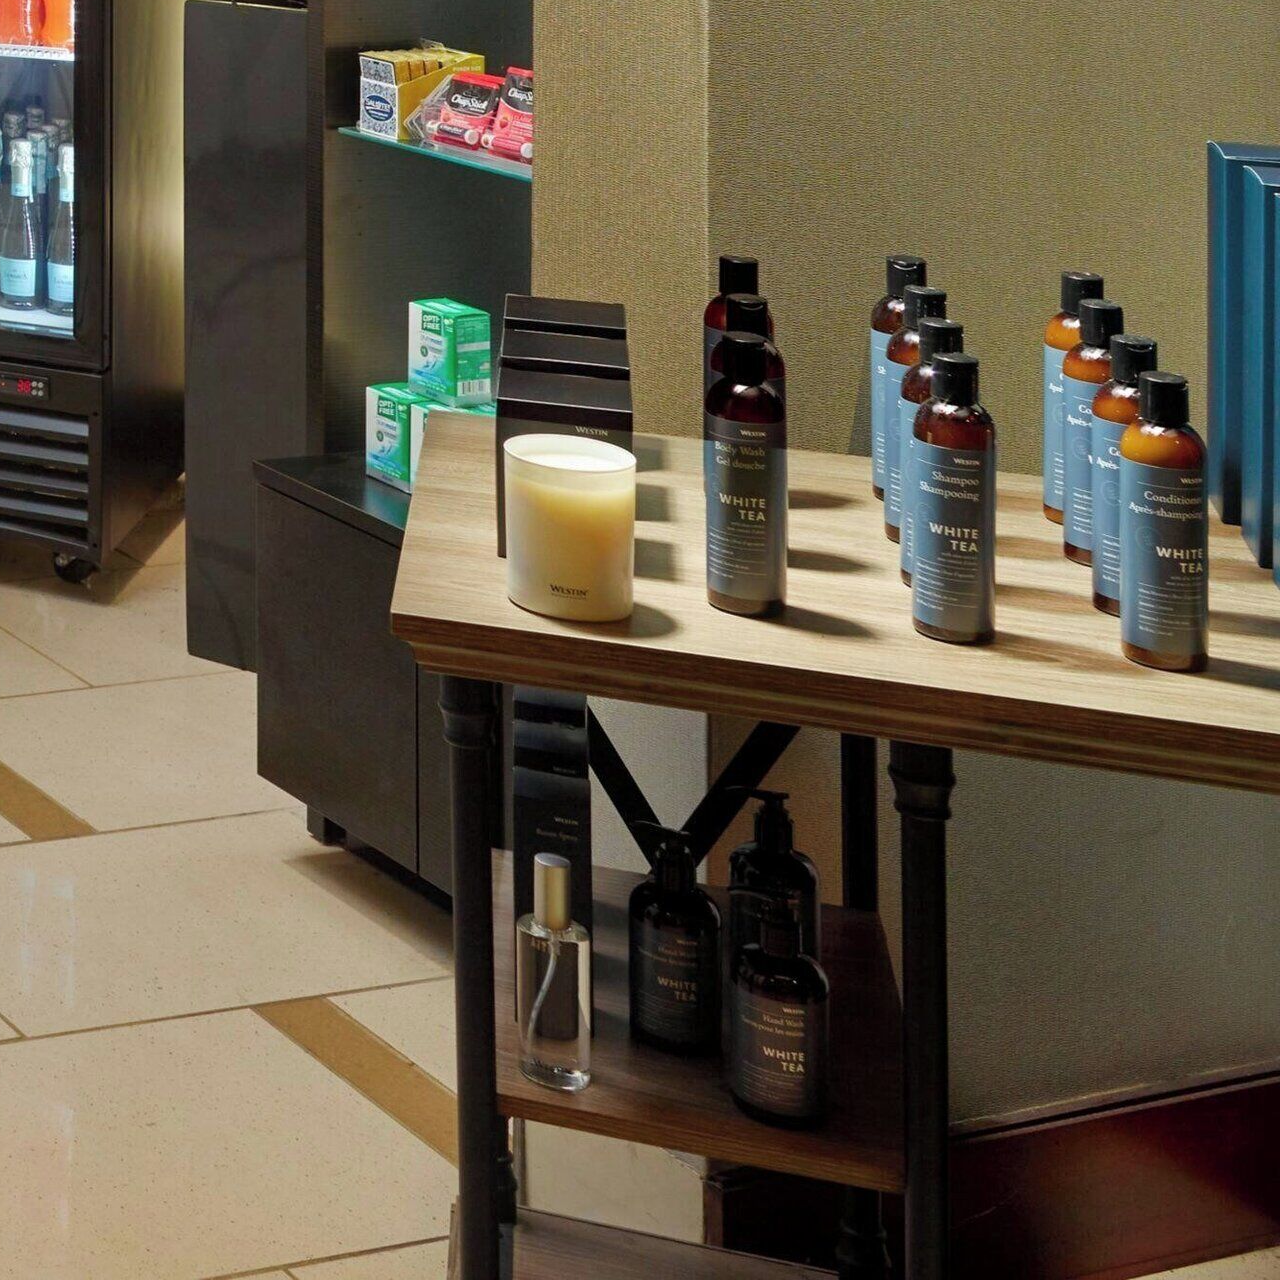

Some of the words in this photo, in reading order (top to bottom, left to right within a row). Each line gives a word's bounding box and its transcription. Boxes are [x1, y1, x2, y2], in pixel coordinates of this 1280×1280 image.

[451, 93, 488, 109] ChapStick
[575, 425, 609, 437] WESTIN
[714, 441, 737, 455] Body
[739, 446, 766, 457] Wash
[716, 455, 731, 465] Gel
[932, 471, 980, 487] Shampoo
[919, 480, 980, 502] Shampooing
[718, 492, 767, 509] WHITE
[738, 509, 766, 521] TEA
[928, 521, 980, 539] WHITE
[950, 540, 980, 553] TEA
[1155, 545, 1203, 560] WHITE
[1179, 562, 1204, 574] TEA
[549, 583, 589, 597] WESTIN
[657, 975, 697, 992] WHITE
[762, 1046, 806, 1063] WHITE
[780, 1061, 805, 1074] TEA
